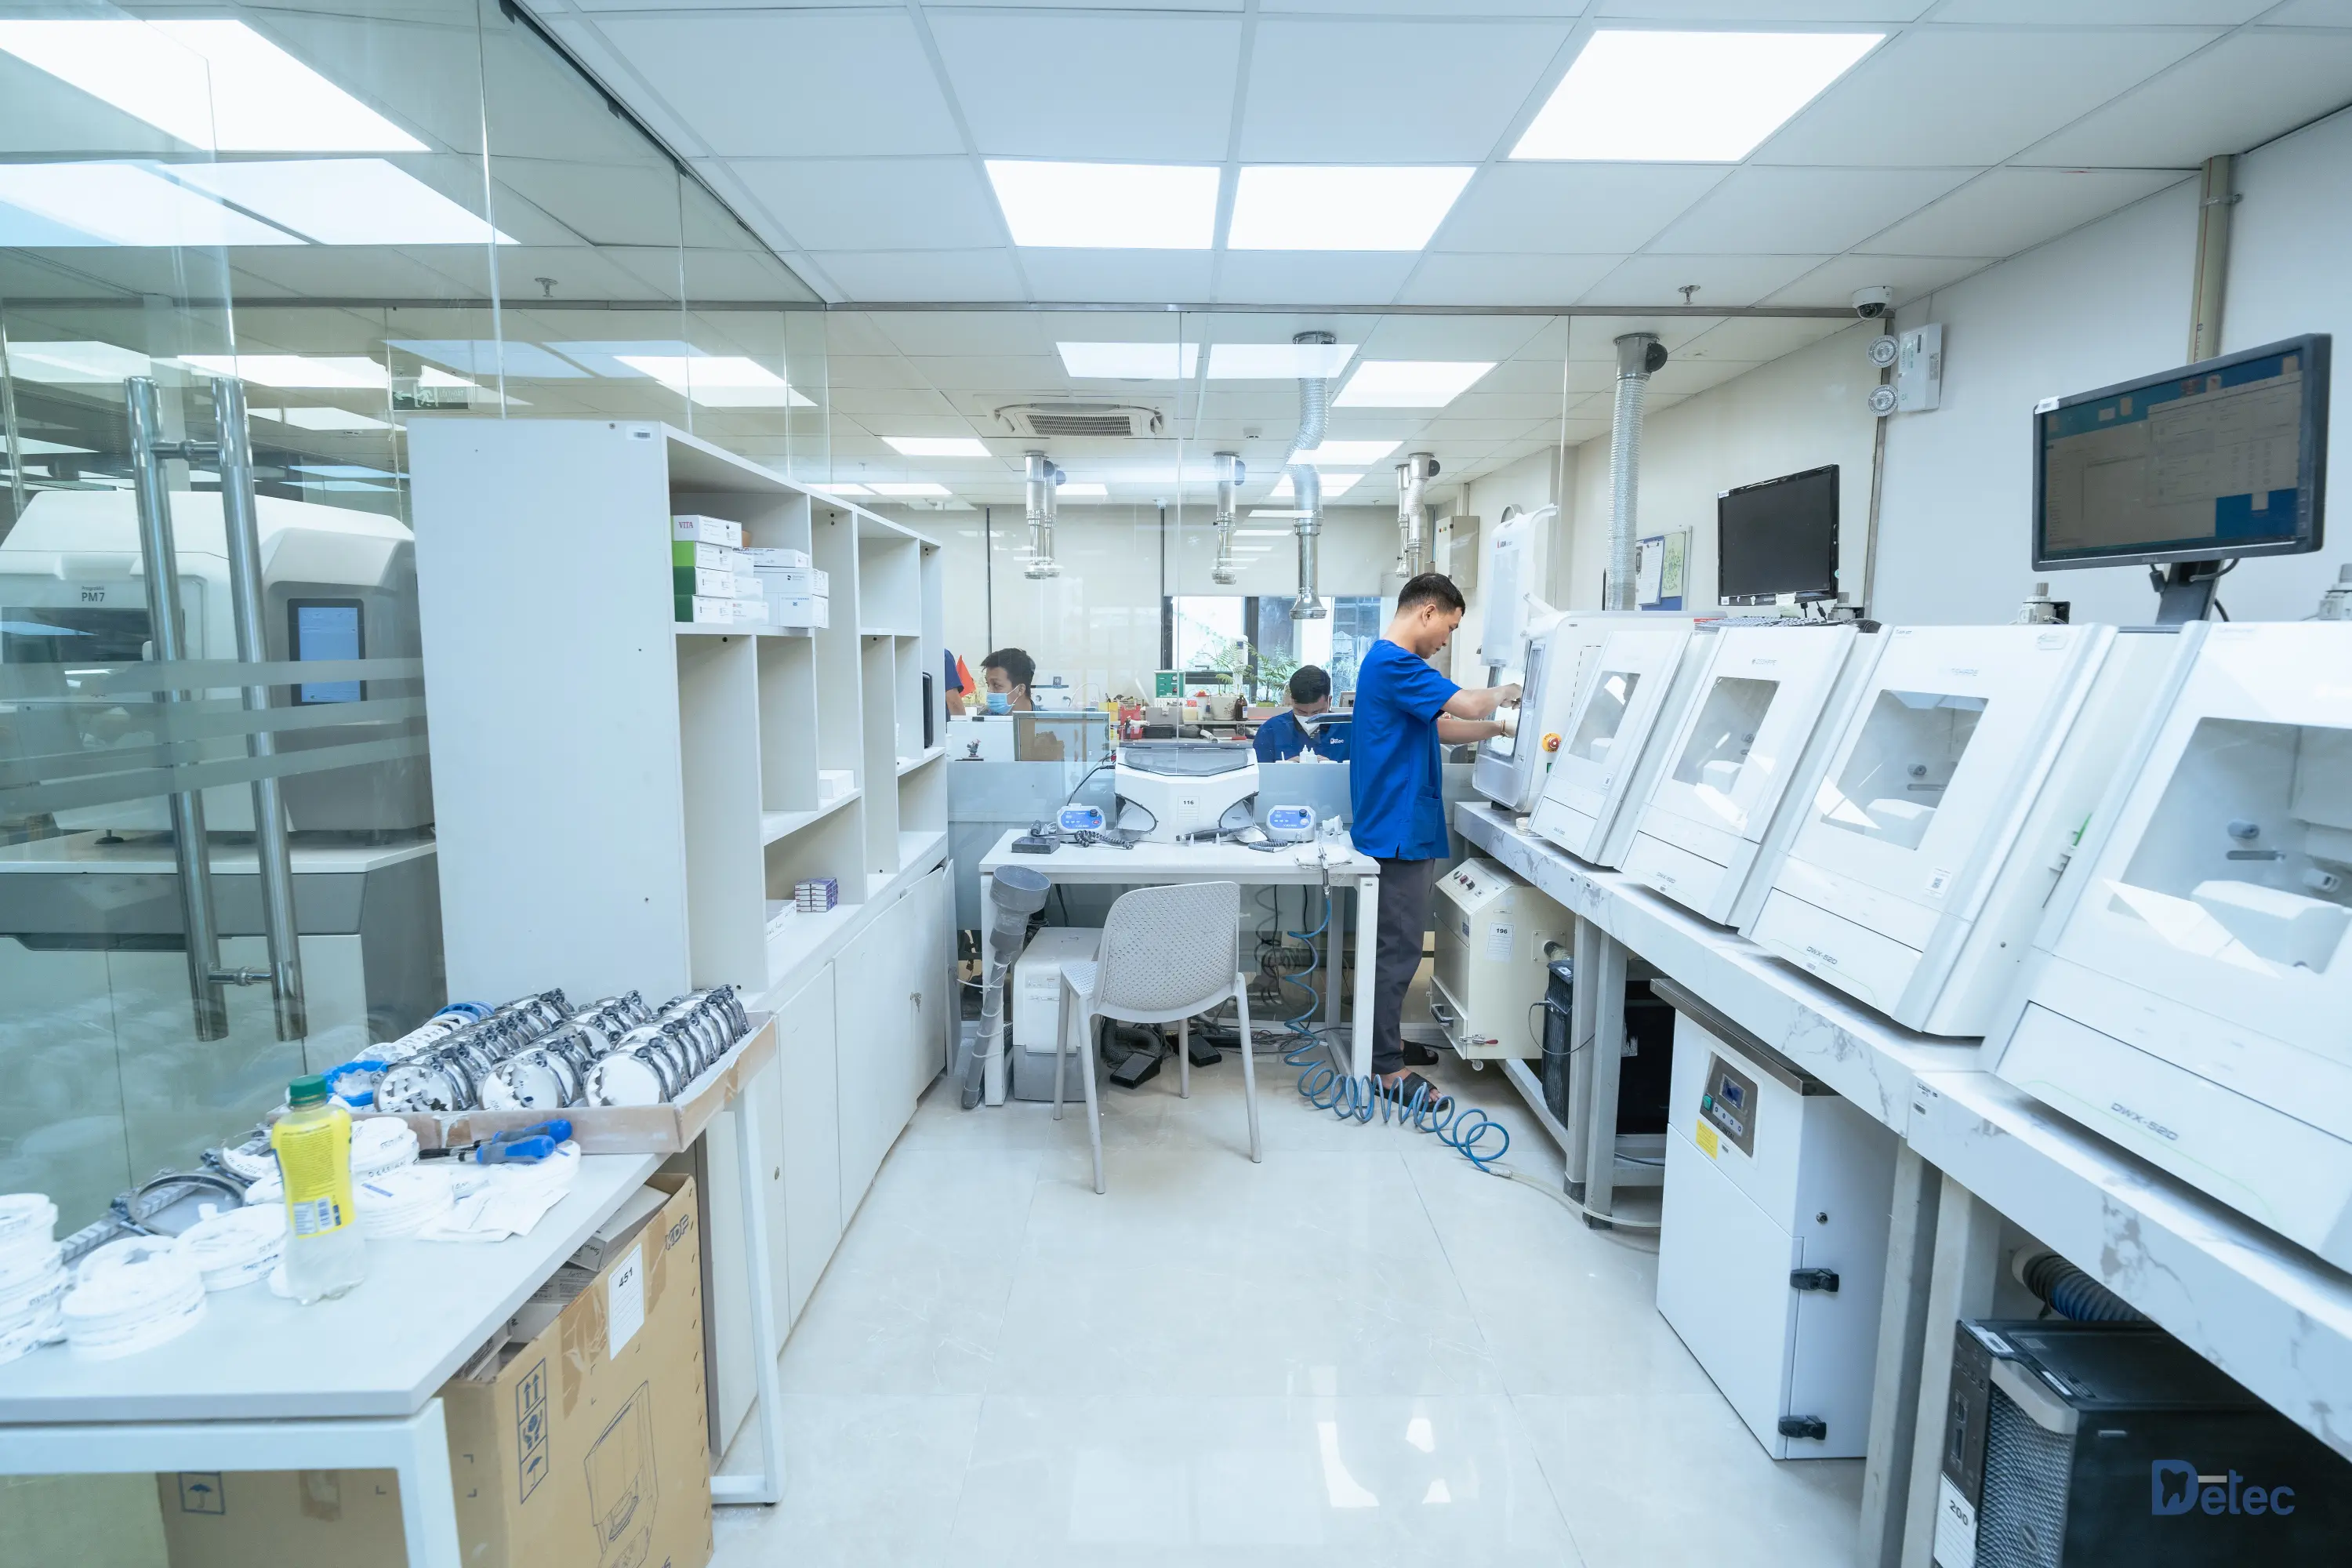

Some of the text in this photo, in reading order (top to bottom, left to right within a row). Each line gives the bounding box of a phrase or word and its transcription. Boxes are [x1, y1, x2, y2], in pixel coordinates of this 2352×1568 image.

[665, 1214, 689, 1250] KDF
[619, 1267, 633, 1287] 451
[1950, 1500, 1969, 1526] 200
